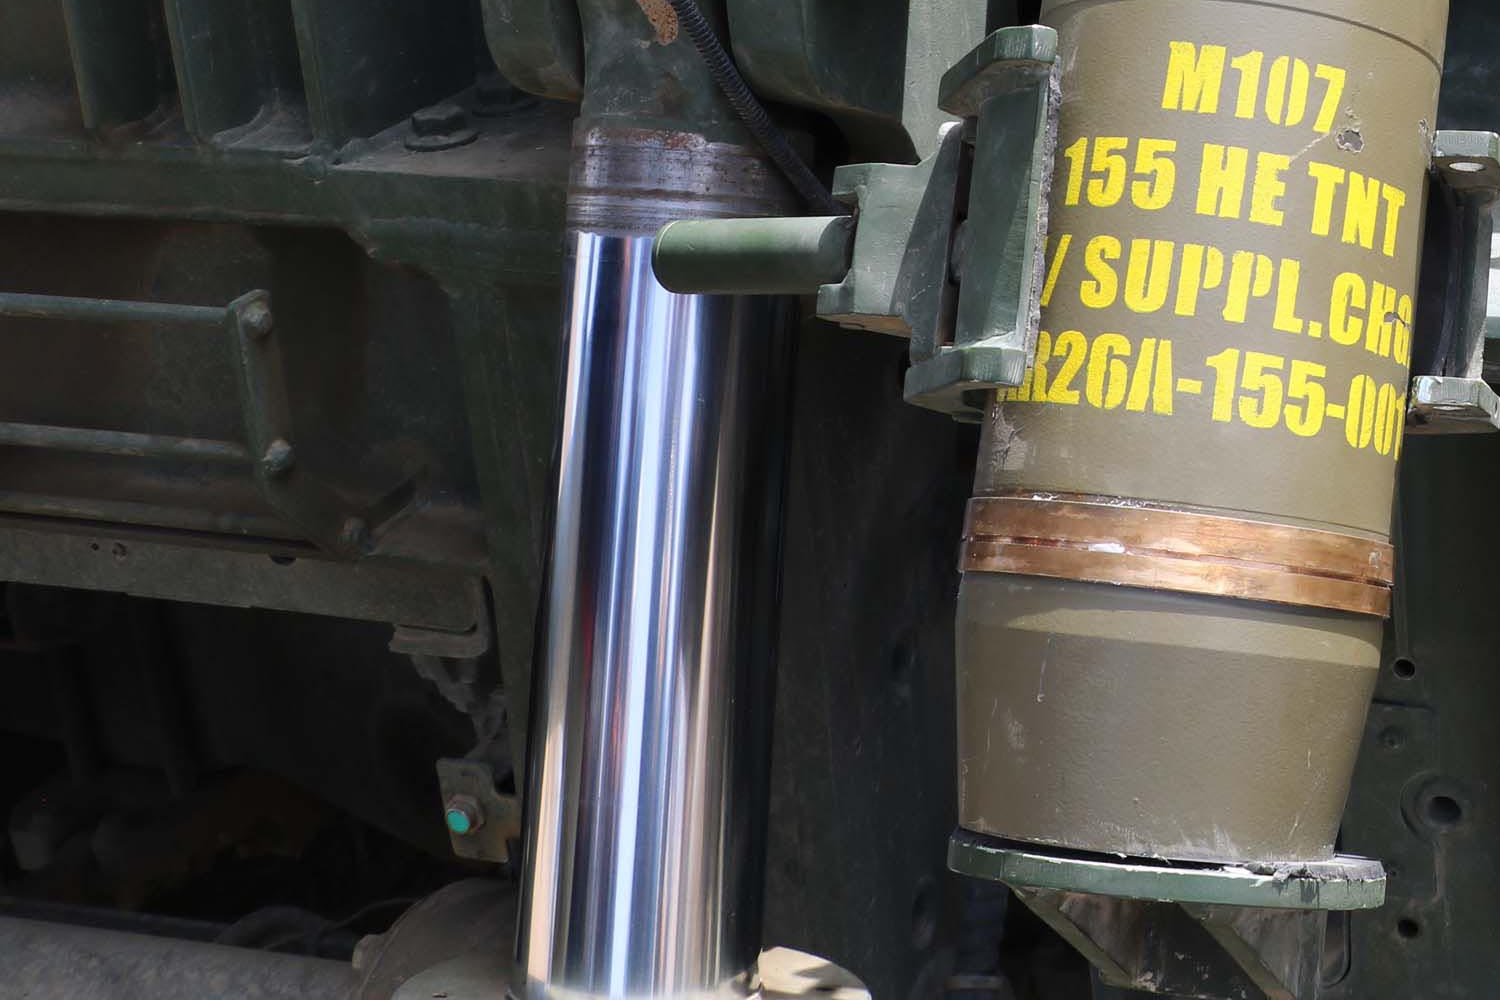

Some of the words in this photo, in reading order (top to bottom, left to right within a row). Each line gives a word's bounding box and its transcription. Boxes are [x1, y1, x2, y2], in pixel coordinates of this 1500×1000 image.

[1161, 42, 1346, 133] M107
[1064, 136, 1176, 210] 155
[1195, 144, 1290, 226] HE
[1308, 163, 1407, 258] TNT
